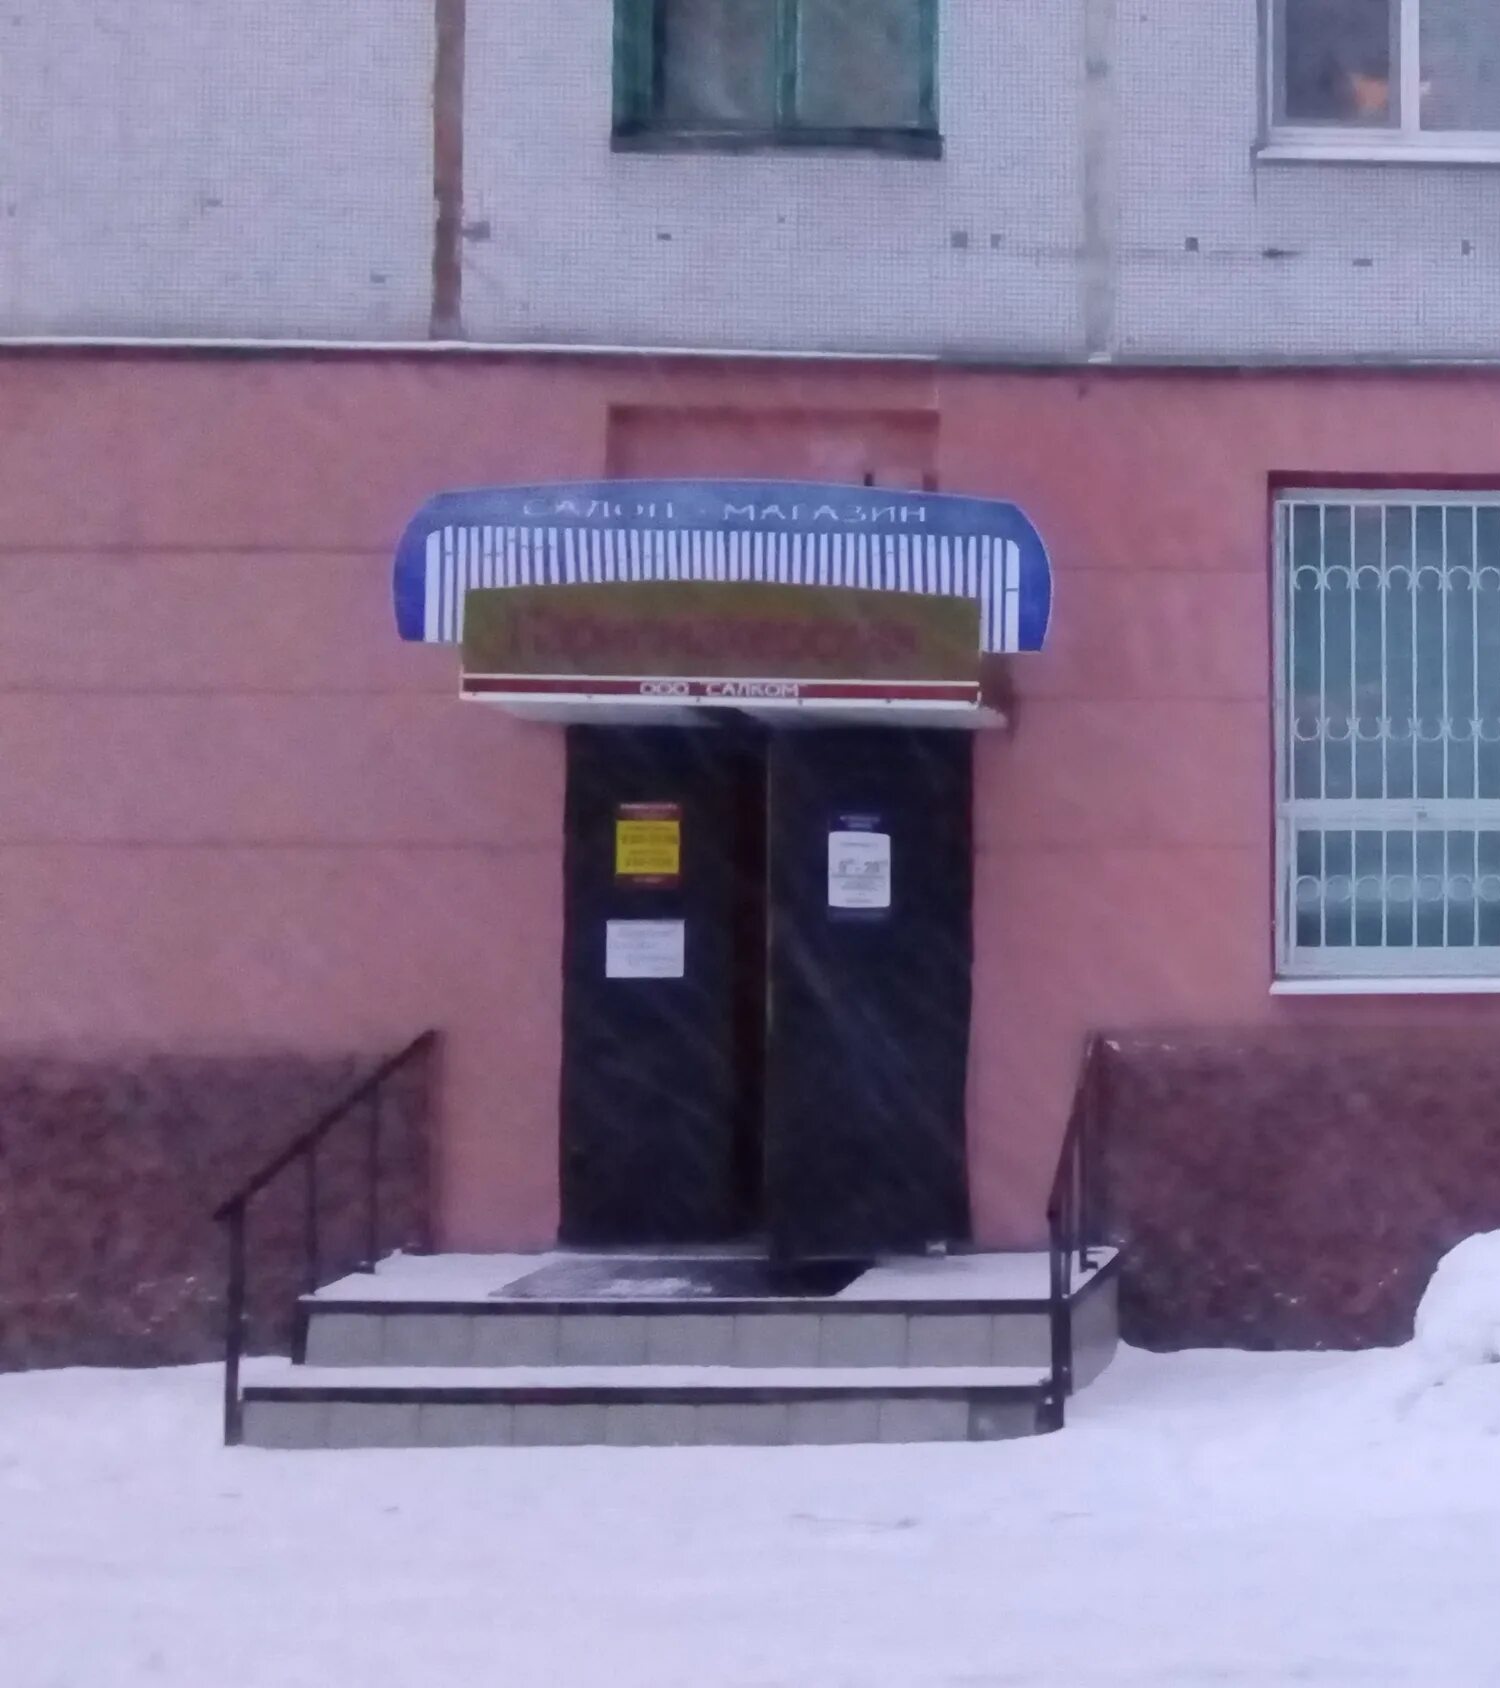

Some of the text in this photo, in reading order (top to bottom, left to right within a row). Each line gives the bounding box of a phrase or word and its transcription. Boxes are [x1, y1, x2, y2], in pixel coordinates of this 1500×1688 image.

[722, 504, 926, 523] МАГАЗИН
[639, 682, 799, 697] ООО САЛКОМ
